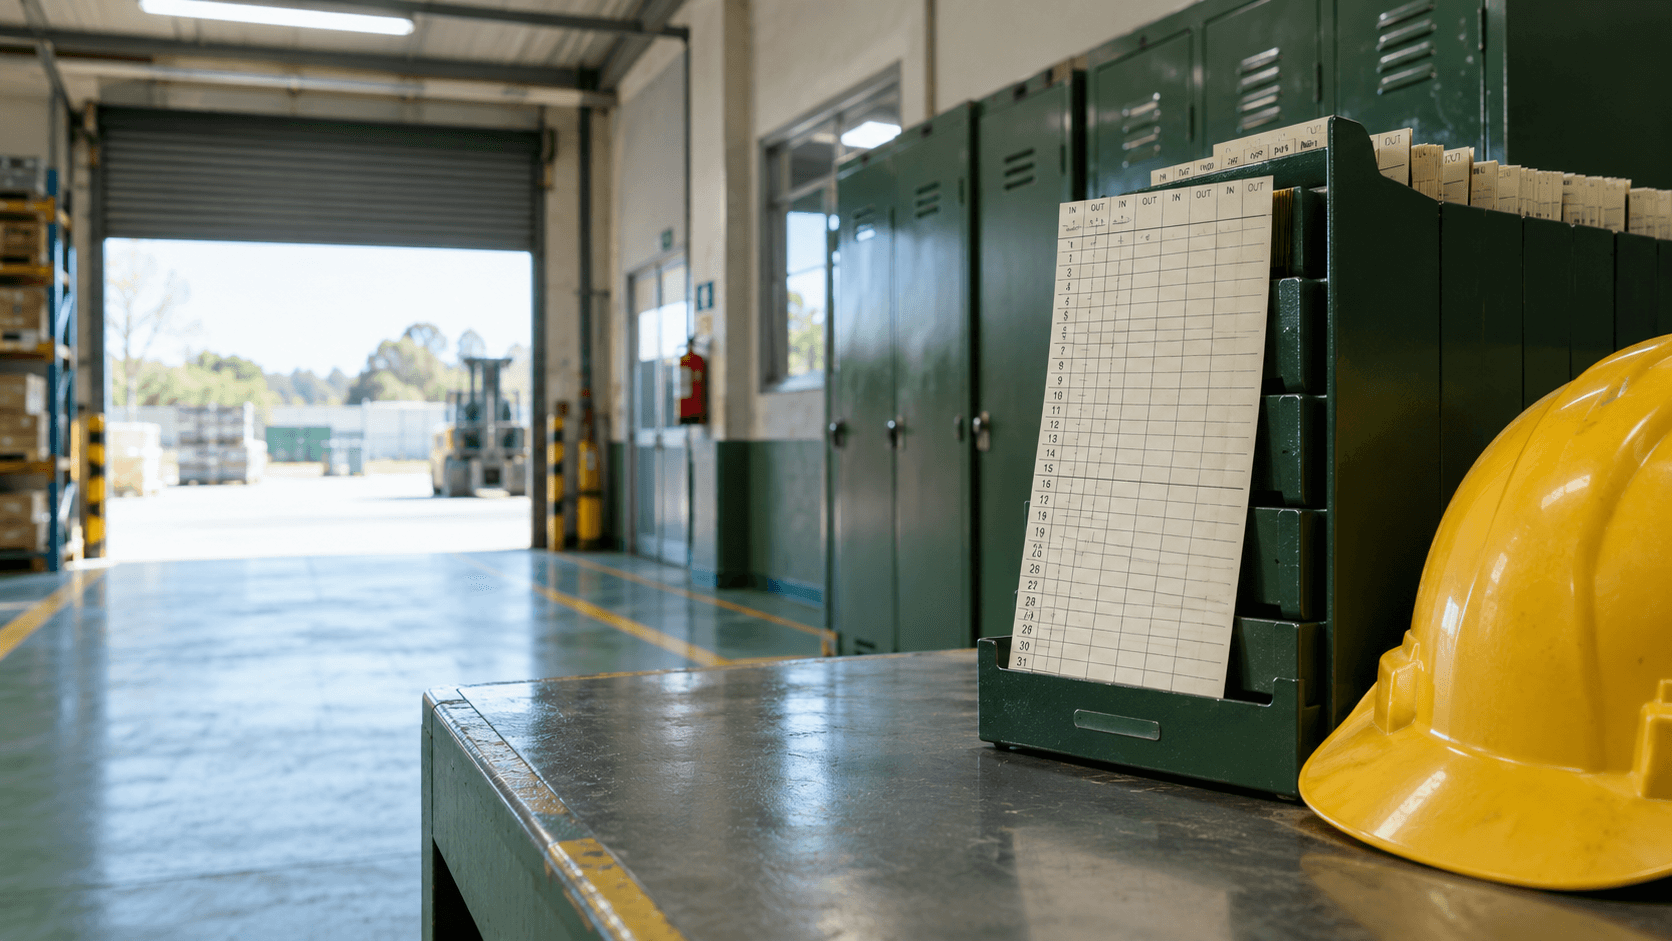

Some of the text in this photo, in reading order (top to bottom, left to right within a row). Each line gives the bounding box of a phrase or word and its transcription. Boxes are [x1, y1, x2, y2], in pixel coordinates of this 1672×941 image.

[1068, 182, 1264, 214] IN OUT IN OUT IN OUT IN OUT
[1057, 376, 1063, 385] 9
[1053, 391, 1063, 400] 10
[1052, 406, 1061, 415] 11
[1050, 420, 1060, 429] 12
[1048, 434, 1058, 443] 13
[1046, 449, 1055, 458] 14
[1044, 464, 1054, 473] 15
[1042, 479, 1051, 488] 16
[1019, 640, 1030, 651] 30
[1016, 656, 1027, 667] 31
